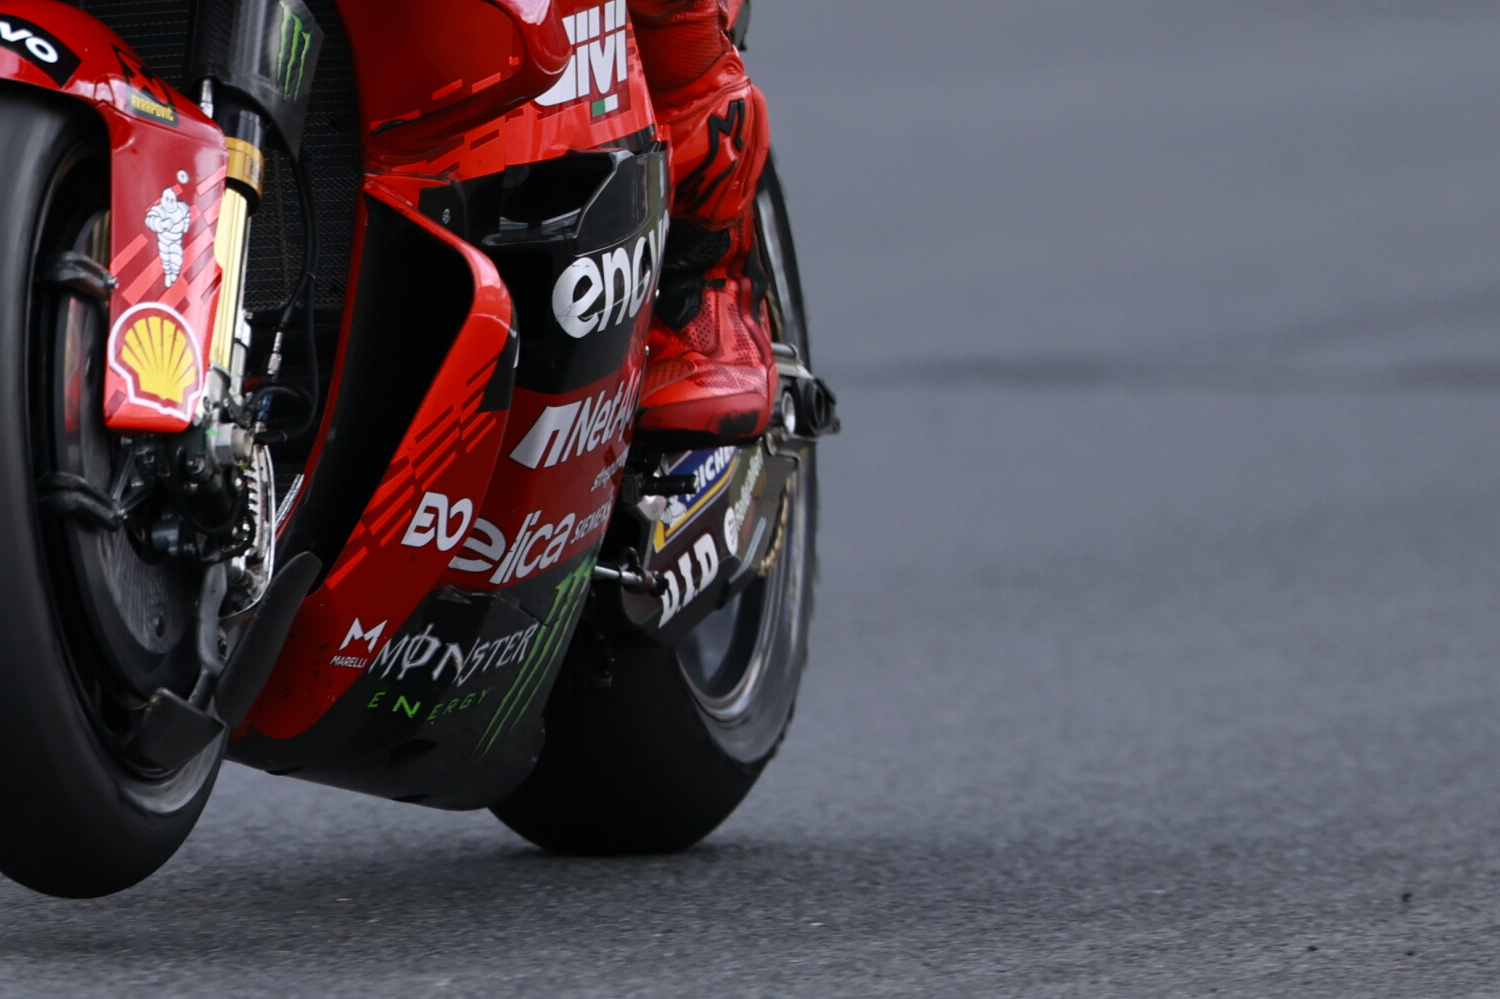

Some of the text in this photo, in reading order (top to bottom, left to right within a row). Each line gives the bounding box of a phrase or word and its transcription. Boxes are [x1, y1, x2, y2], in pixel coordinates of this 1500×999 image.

[329, 655, 369, 669] MARELLI
[368, 622, 540, 688] MONSTER
[367, 686, 493, 721] ENERGY
